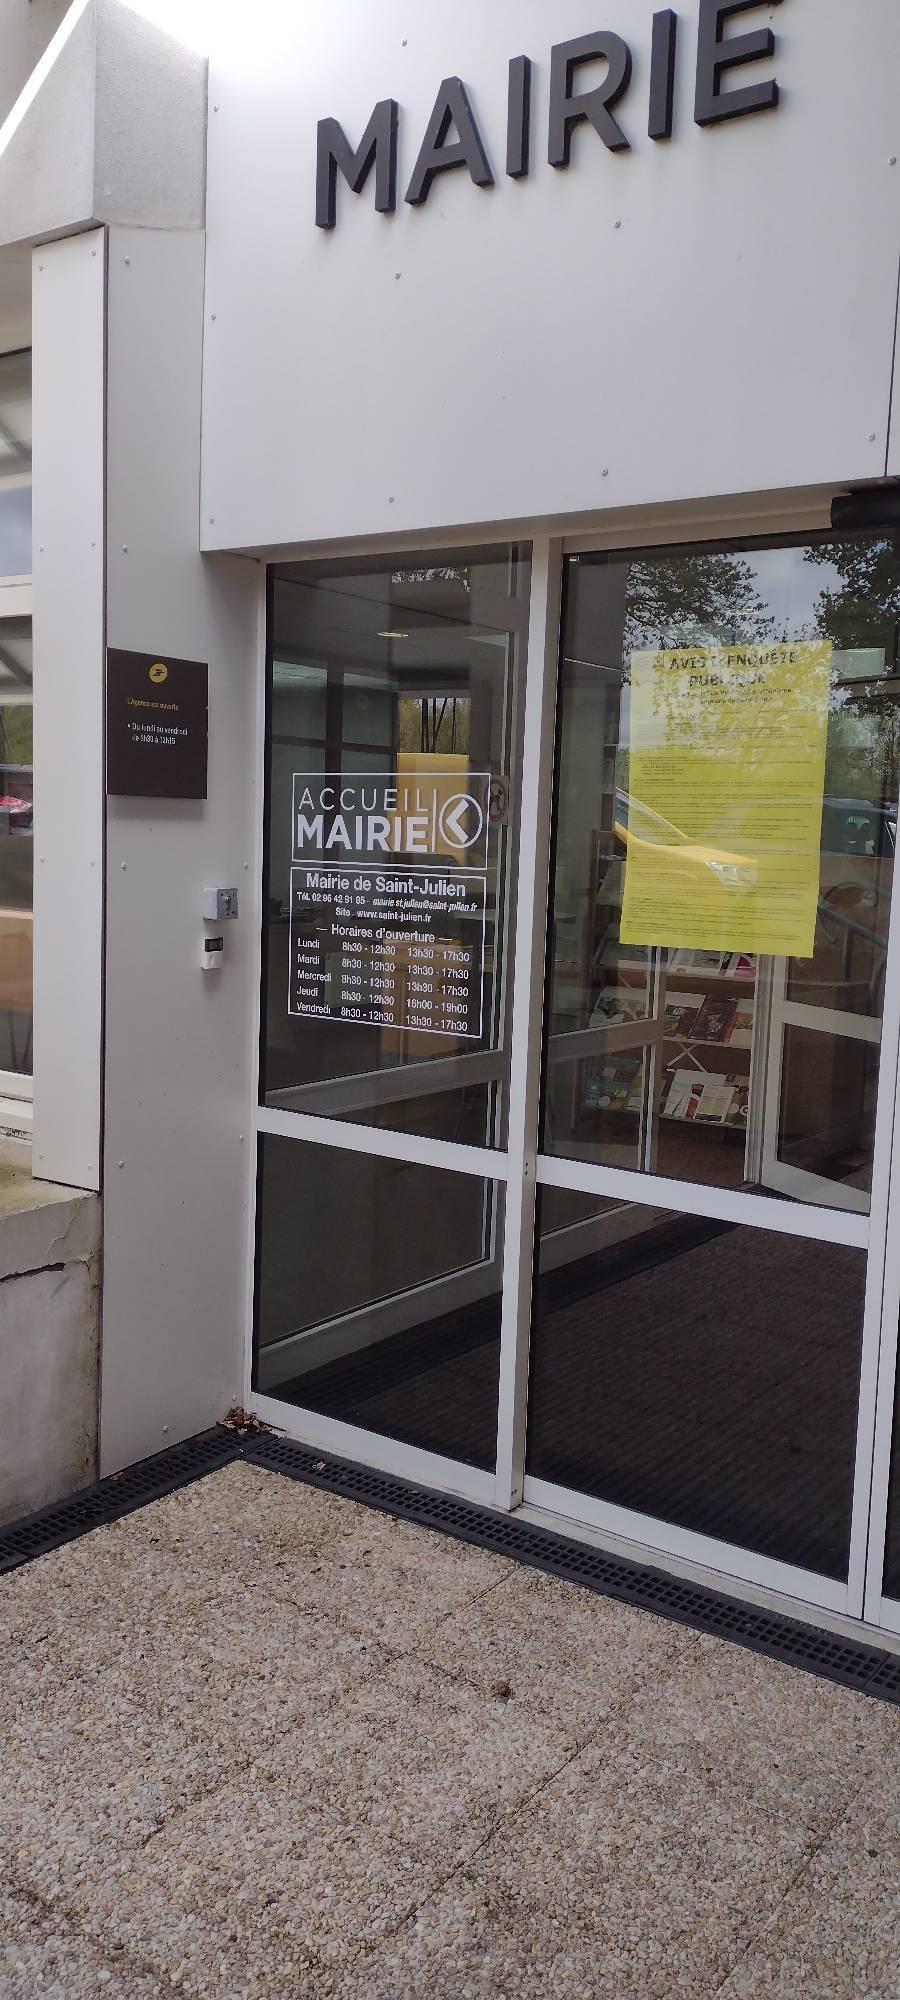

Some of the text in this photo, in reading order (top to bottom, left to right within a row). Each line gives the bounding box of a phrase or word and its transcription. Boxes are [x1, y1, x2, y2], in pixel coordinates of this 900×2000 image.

[314, 0, 780, 230] MAIRIE
[298, 787, 429, 812] ACCUEIL
[297, 814, 429, 853] MAIRIE
[306, 873, 466, 897] Mairie de Saint-Julien
[312, 893, 322, 902] 02
[322, 894, 332, 903] 96
[333, 894, 343, 904] 42
[344, 895, 353, 904] 91
[356, 911, 432, 923] www.saint-julien.fr
[331, 924, 436, 943] Horaires d'ouverture
[297, 938, 320, 949] Lundi
[342, 942, 363, 953] 8h30
[370, 945, 396, 956] 12h30
[407, 948, 434, 959] 13h30
[443, 951, 470, 962] 17h30
[297, 954, 320, 965] Mardi
[341, 958, 362, 969] 8h30
[369, 961, 396, 972] 12h30
[407, 965, 434, 976] 13h30
[442, 968, 470, 980] 17h30
[297, 970, 332, 982] Mercredi
[341, 975, 362, 986] 8h30
[369, 978, 395, 990] 12h30
[406, 982, 433, 993] 13h30
[441, 985, 469, 997] 17h30
[296, 985, 319, 997] Jeudi
[341, 991, 361, 1002] 8h30
[369, 994, 395, 1006] 12h30
[440, 1003, 468, 1015] 19h00
[296, 1001, 331, 1015] Vendredi
[340, 1007, 361, 1018] 8h30
[368, 1011, 394, 1022] 12h30
[405, 1015, 432, 1027] 13h30
[440, 1019, 468, 1032] 17h30
